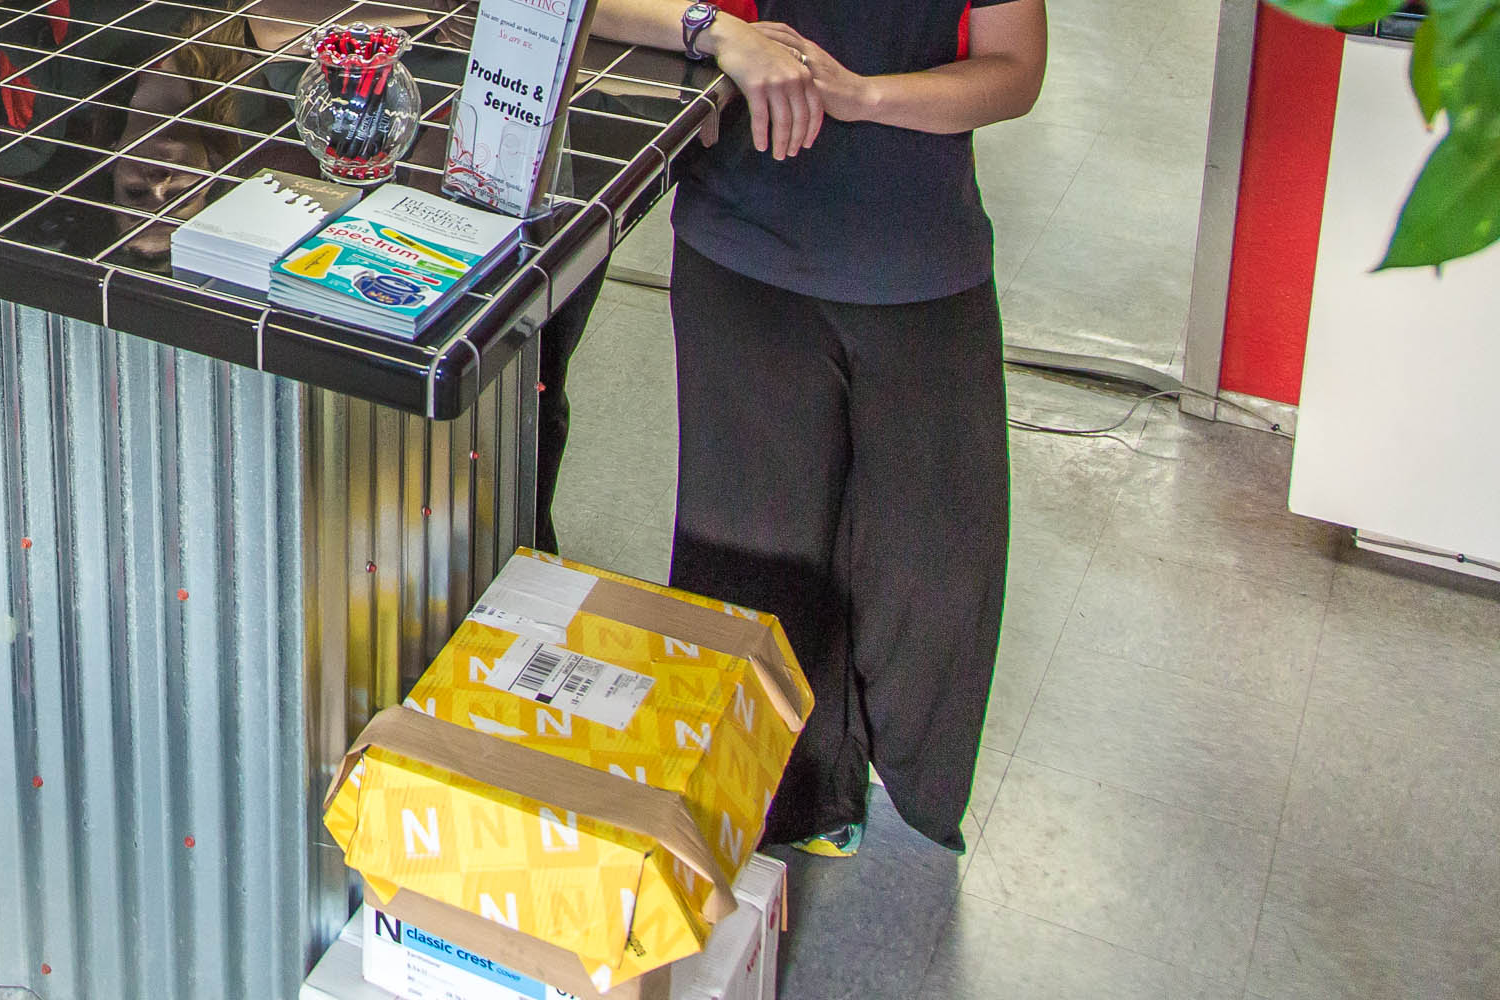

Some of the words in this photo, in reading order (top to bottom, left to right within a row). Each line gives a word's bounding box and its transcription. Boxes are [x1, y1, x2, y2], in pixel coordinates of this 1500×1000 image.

[524, 26, 538, 37] what
[470, 58, 529, 96] Products
[533, 85, 543, 103] &
[484, 91, 541, 127] Services
[326, 226, 420, 261] spectrum
[344, 223, 370, 234] 2013
[536, 708, 572, 738] N
[402, 808, 441, 858] N
[540, 807, 578, 852] N
[375, 909, 402, 944] N
[406, 927, 453, 955] classic
[456, 946, 495, 972] crest
[496, 967, 521, 981] cover
